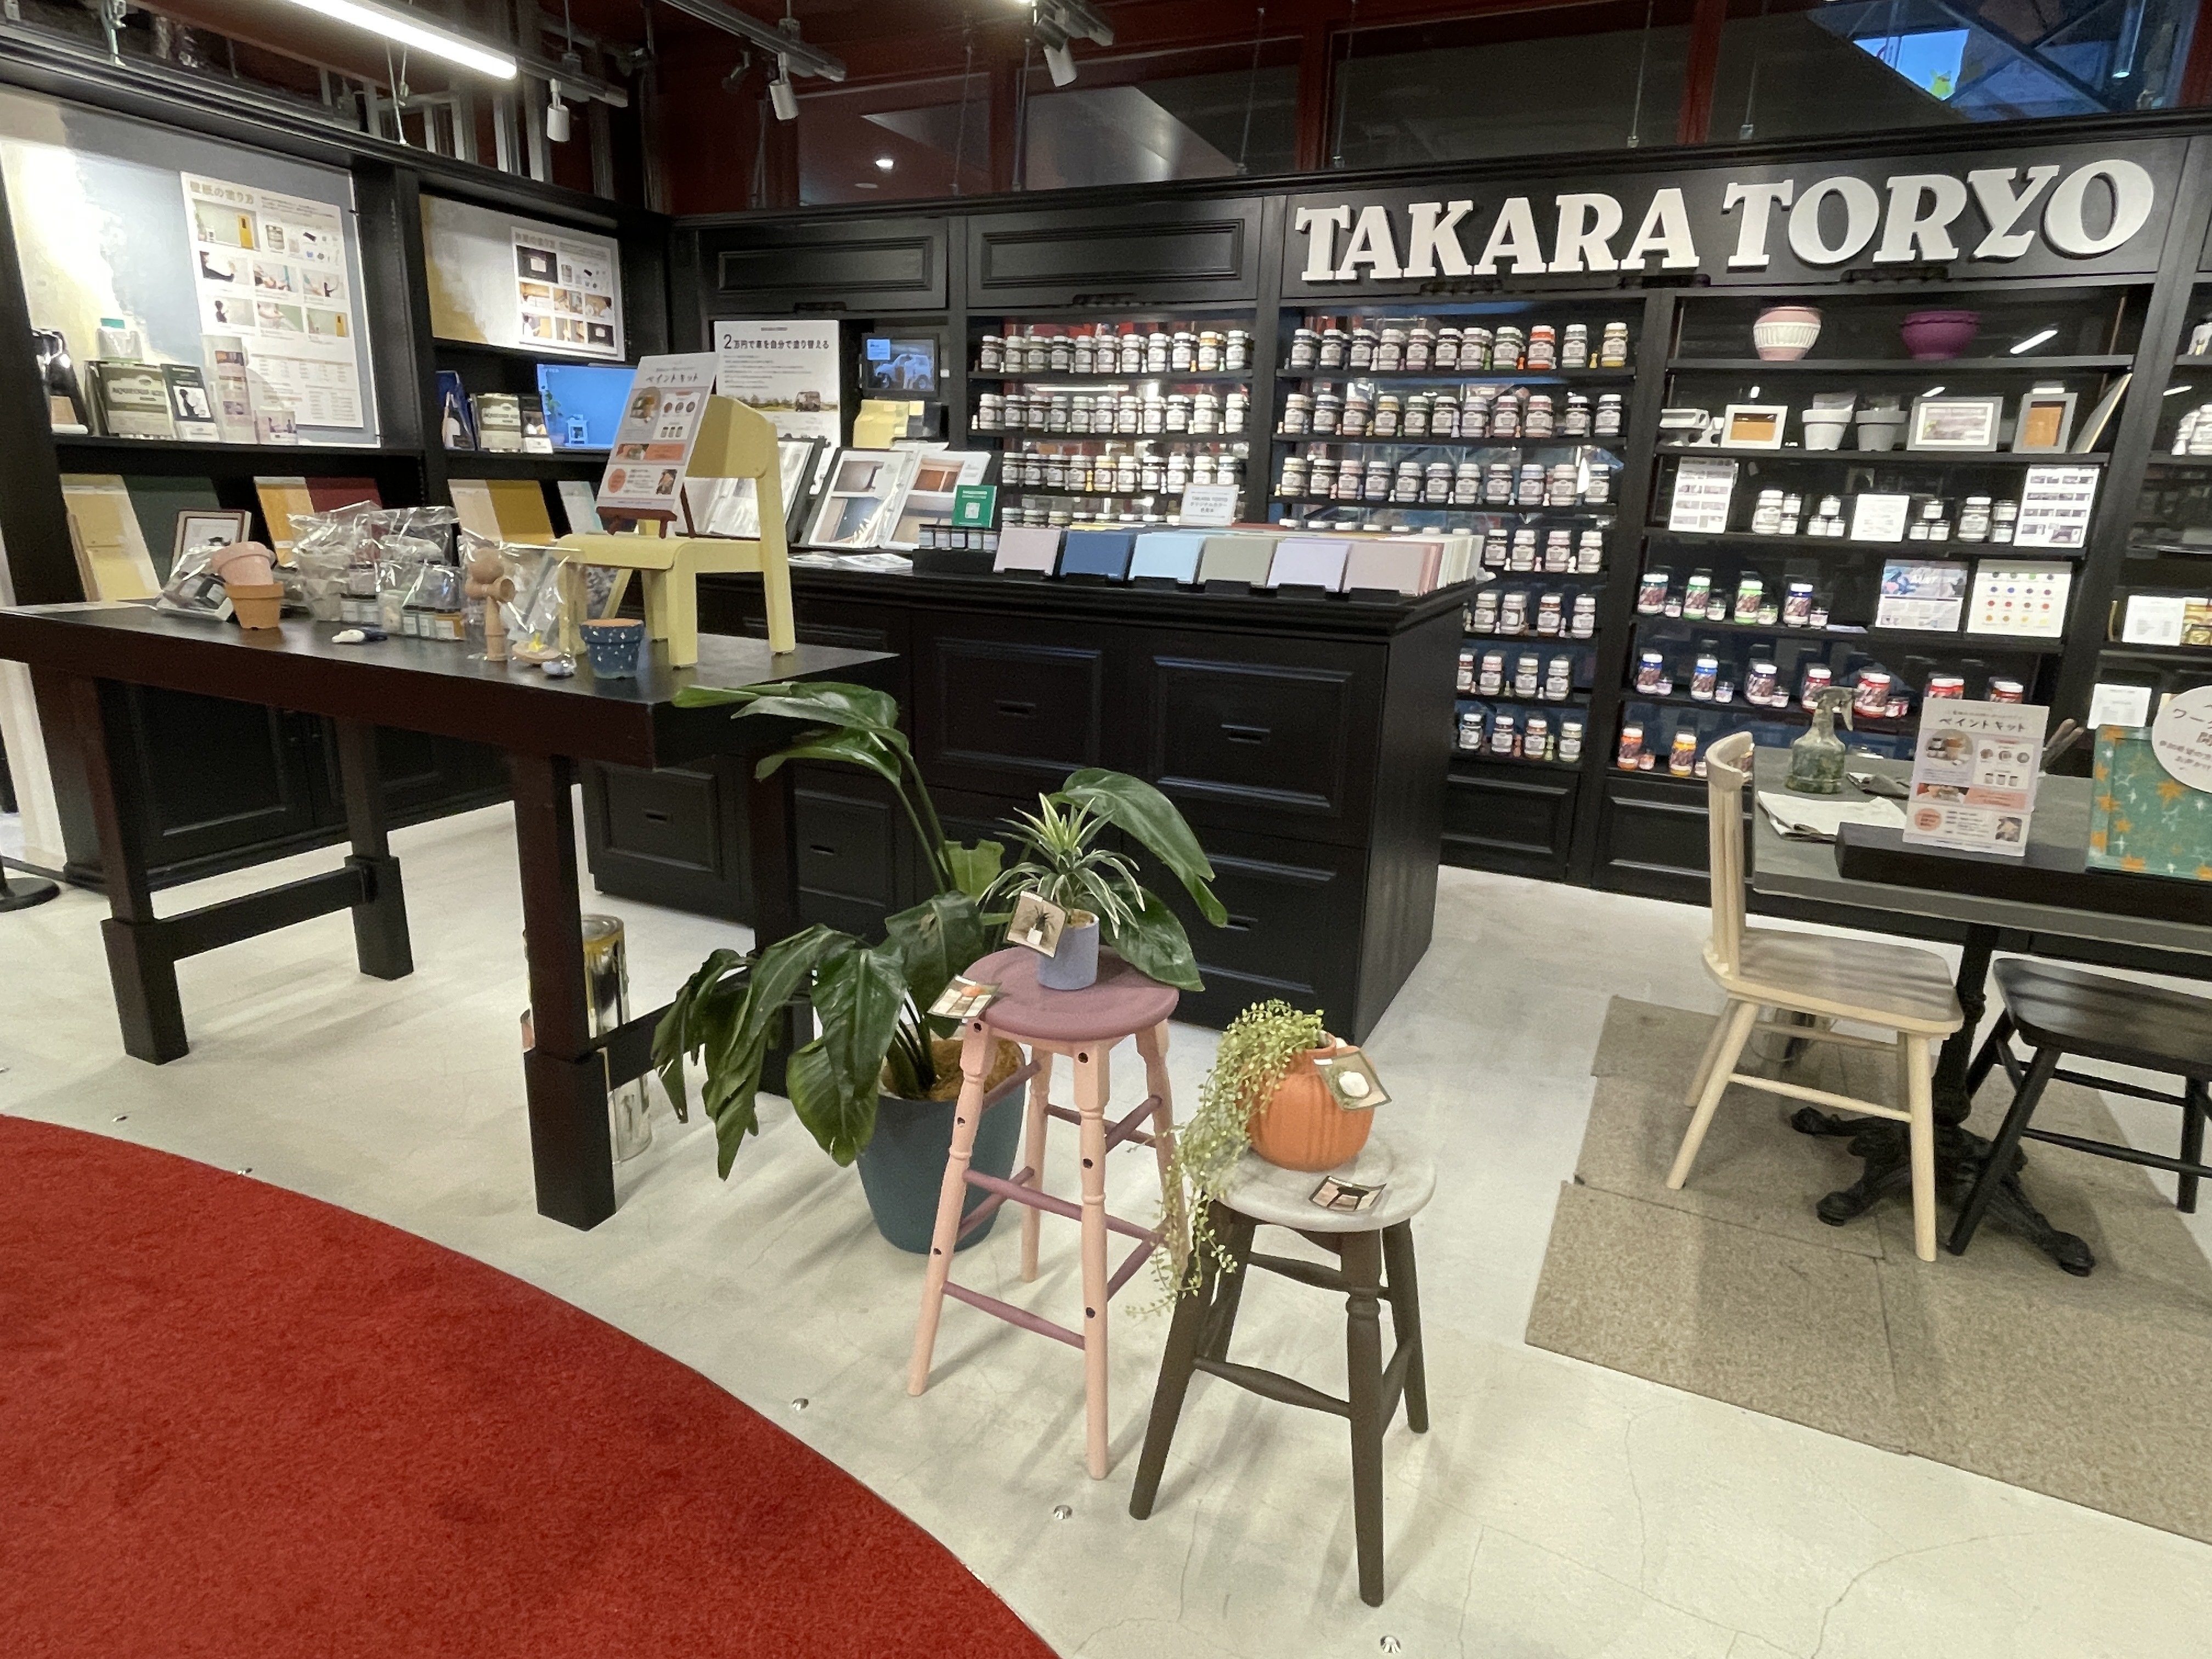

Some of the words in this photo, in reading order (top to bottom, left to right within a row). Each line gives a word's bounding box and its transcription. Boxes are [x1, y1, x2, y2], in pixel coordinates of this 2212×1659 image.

[1295, 187, 1700, 281] TAKARA
[1723, 159, 2155, 266] TORYO
[1939, 718, 2026, 732] ペイントキット
